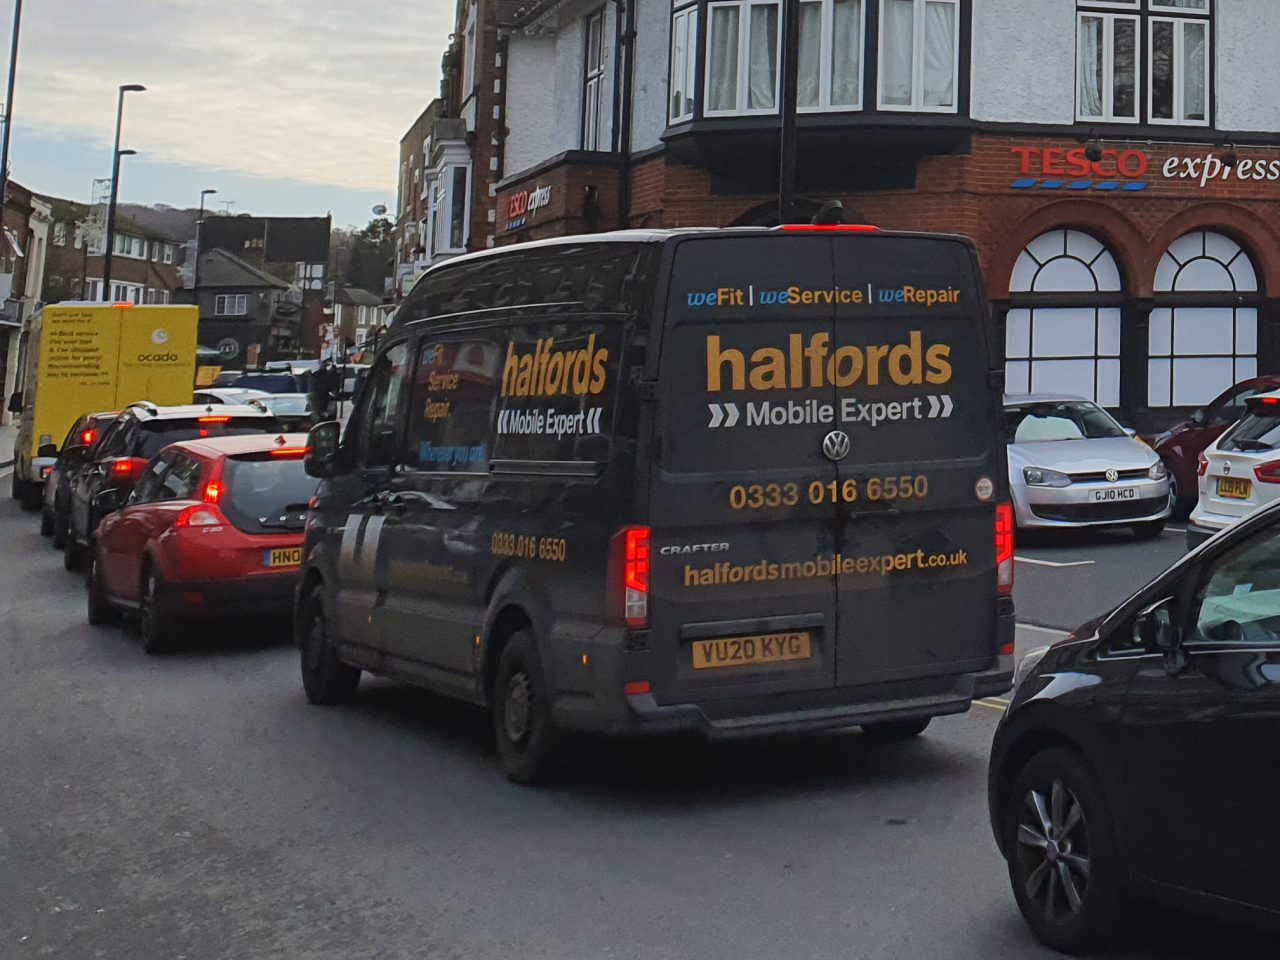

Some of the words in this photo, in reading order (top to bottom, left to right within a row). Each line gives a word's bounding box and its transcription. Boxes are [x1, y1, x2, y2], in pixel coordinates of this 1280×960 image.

[1010, 146, 1149, 178] TESCO
[687, 287, 743, 307] weFit
[760, 286, 863, 305] weService
[879, 286, 961, 307] weRepair
[137, 352, 178, 362] ocado
[501, 334, 609, 397] halfords
[706, 330, 953, 392] halfords
[509, 408, 544, 435] Mobile
[545, 411, 584, 440] Expert
[746, 400, 835, 427] Mobile
[841, 397, 923, 427] Expert
[729, 483, 799, 510] 0333
[808, 479, 857, 505] 016
[866, 474, 928, 500] 6550
[1095, 490, 1115, 500] GJ10
[1117, 489, 1134, 499] HCD
[491, 532, 515, 557] 0333
[517, 535, 536, 559] 016
[539, 537, 566, 562] 6550
[660, 542, 730, 556] CRAFTER
[684, 548, 968, 586] halfordsmobileexpert.co.uk
[702, 640, 756, 663] VU20
[761, 635, 801, 657] KYG
